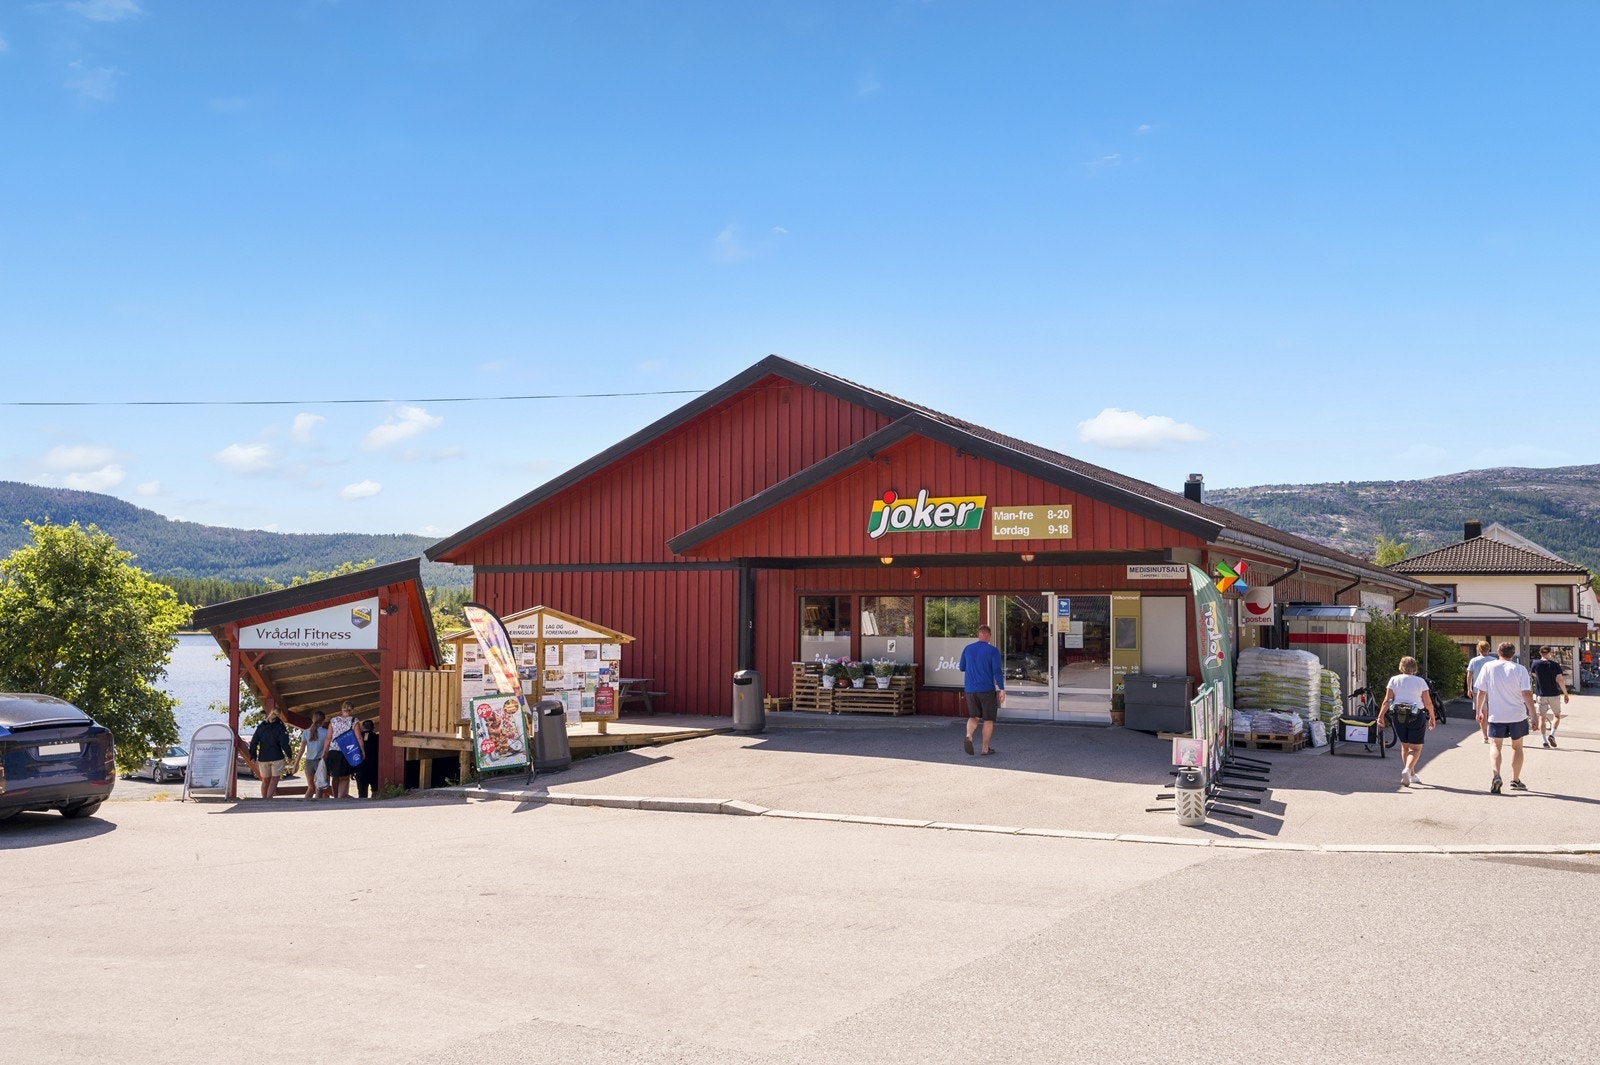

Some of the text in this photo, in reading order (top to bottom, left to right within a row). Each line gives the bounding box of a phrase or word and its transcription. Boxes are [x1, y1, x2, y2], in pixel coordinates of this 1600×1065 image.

[869, 489, 977, 539] joker
[993, 509, 1070, 521] Man-fre 8-20
[993, 525, 1069, 537] Lørdag 9-18
[1245, 616, 1272, 624] posten
[255, 628, 352, 640] Vrådal Fitness
[1204, 606, 1225, 666] joker
